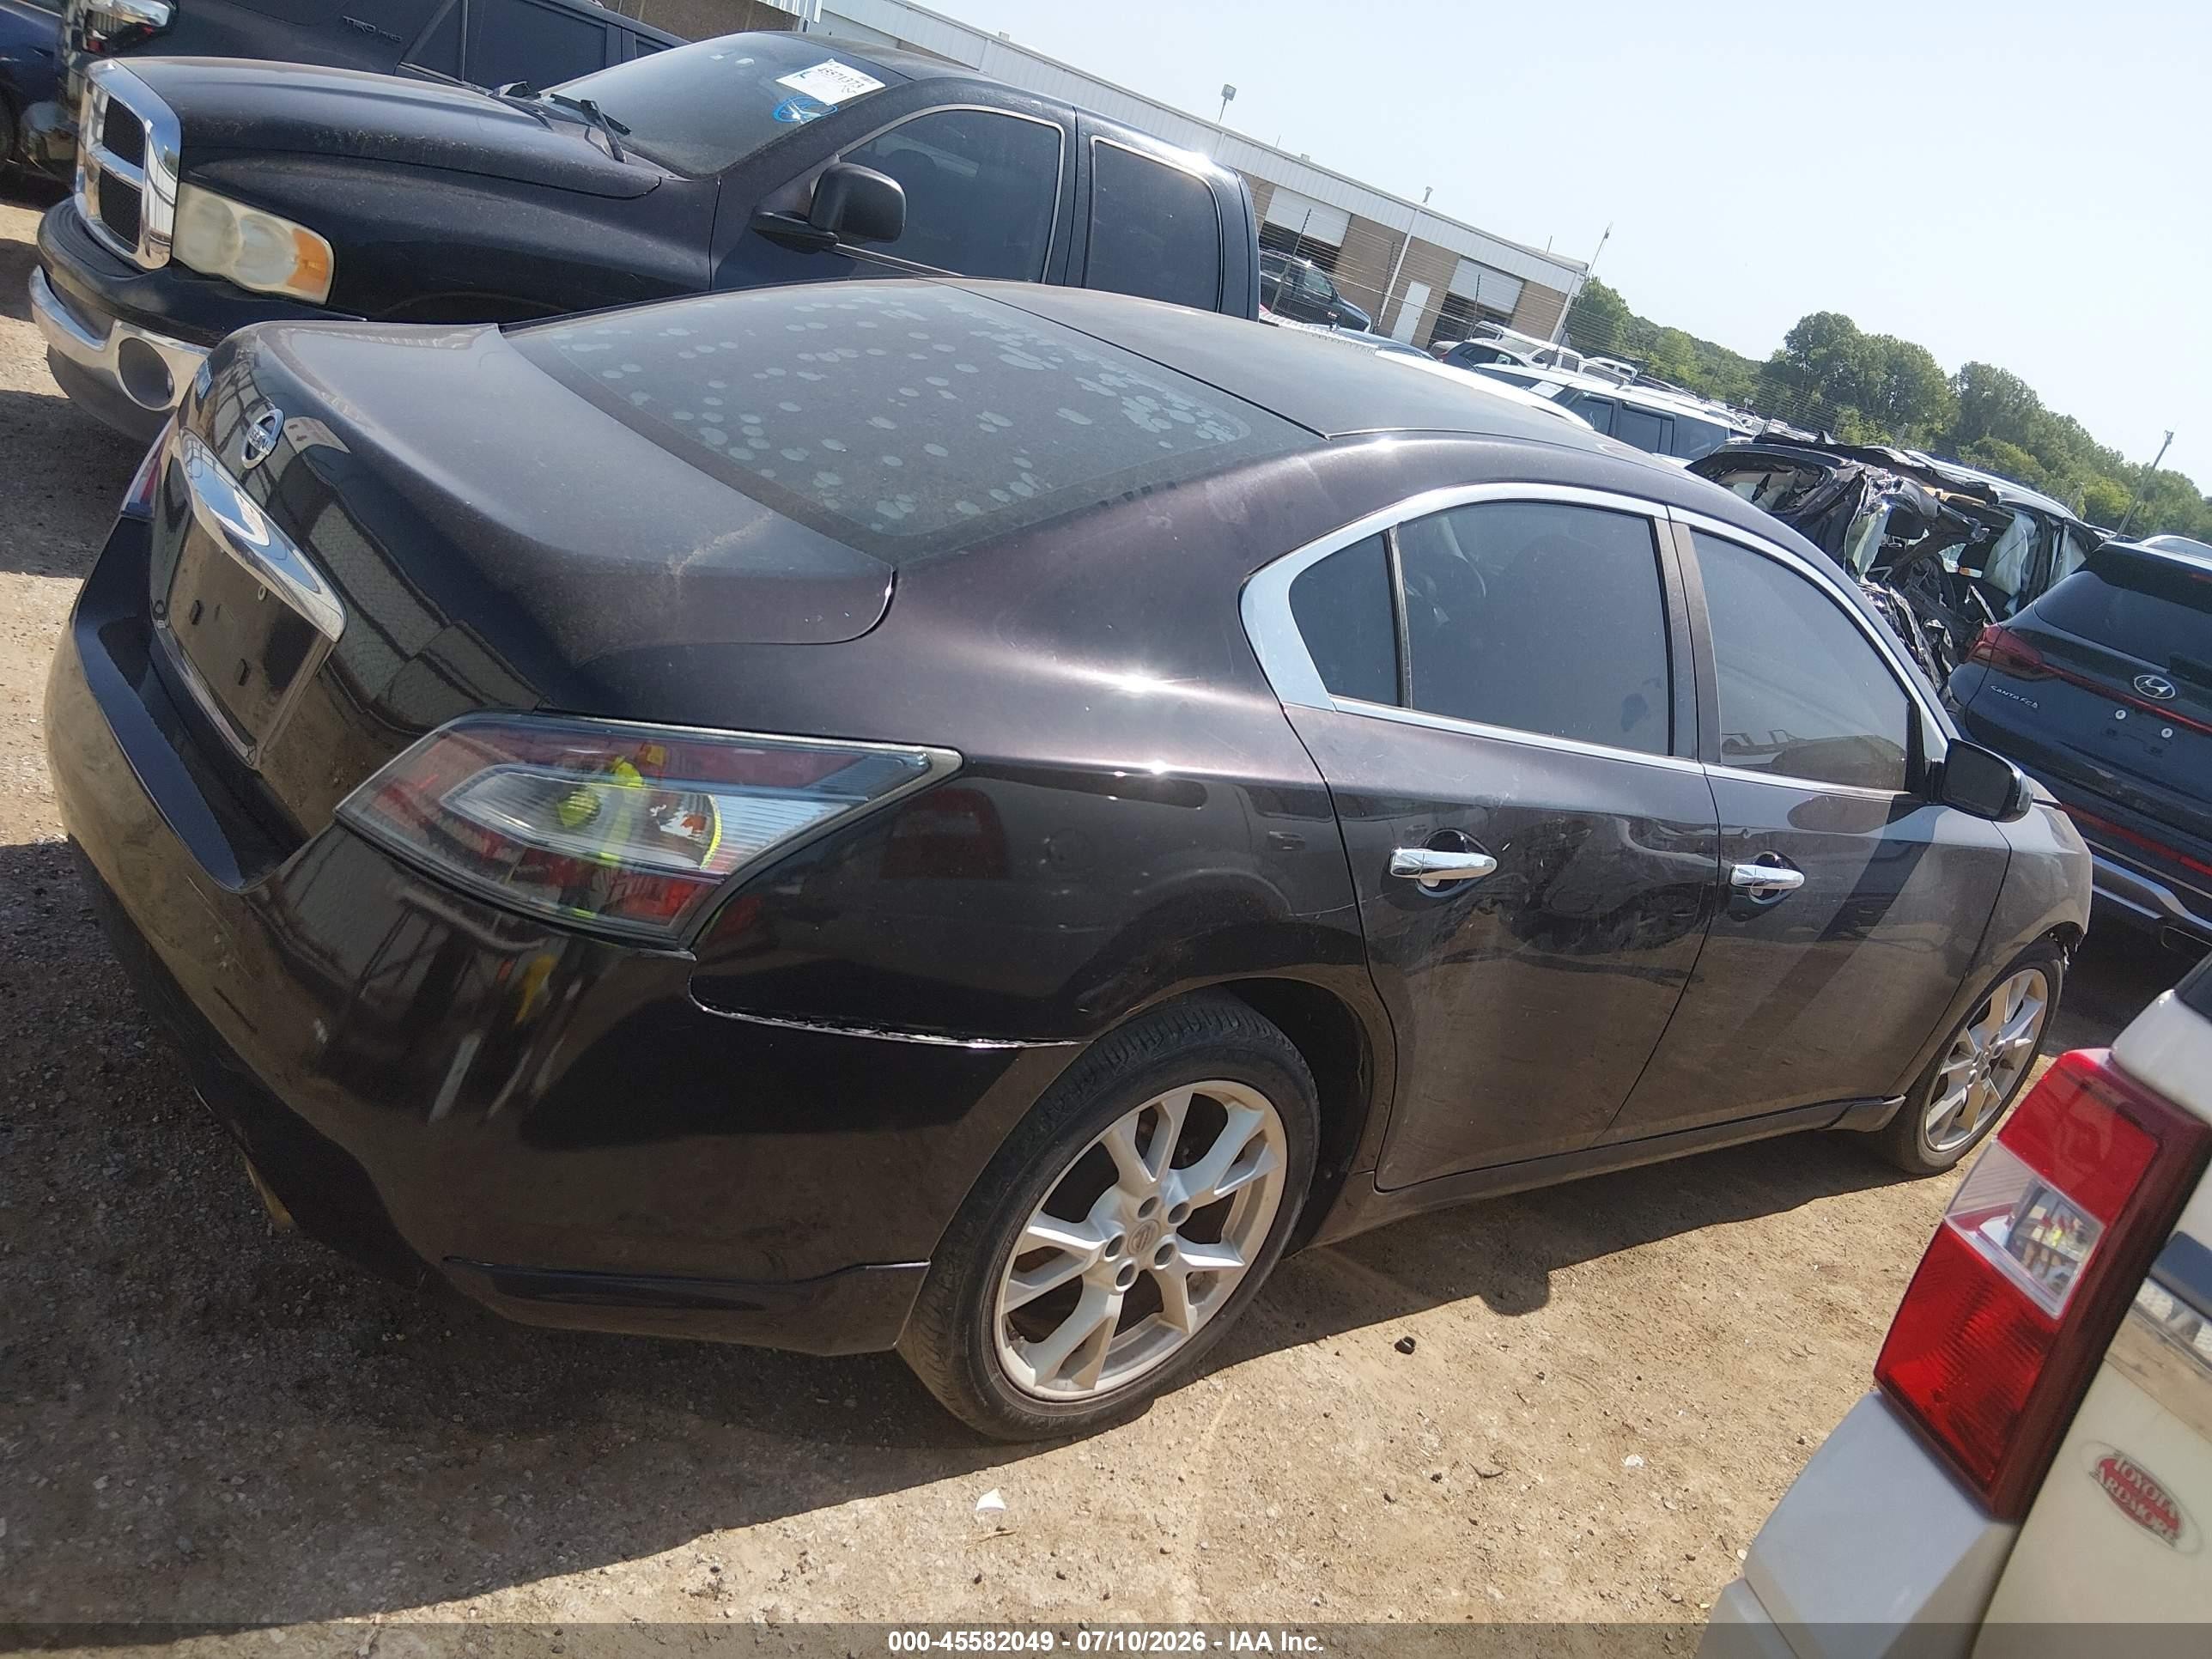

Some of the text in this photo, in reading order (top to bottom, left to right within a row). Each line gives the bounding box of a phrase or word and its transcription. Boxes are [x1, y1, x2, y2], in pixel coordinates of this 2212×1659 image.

[343, 15, 376, 34] TRD
[2090, 1465, 2179, 1547] ARDMORE
[2113, 1450, 2179, 1520] TOYOTA
